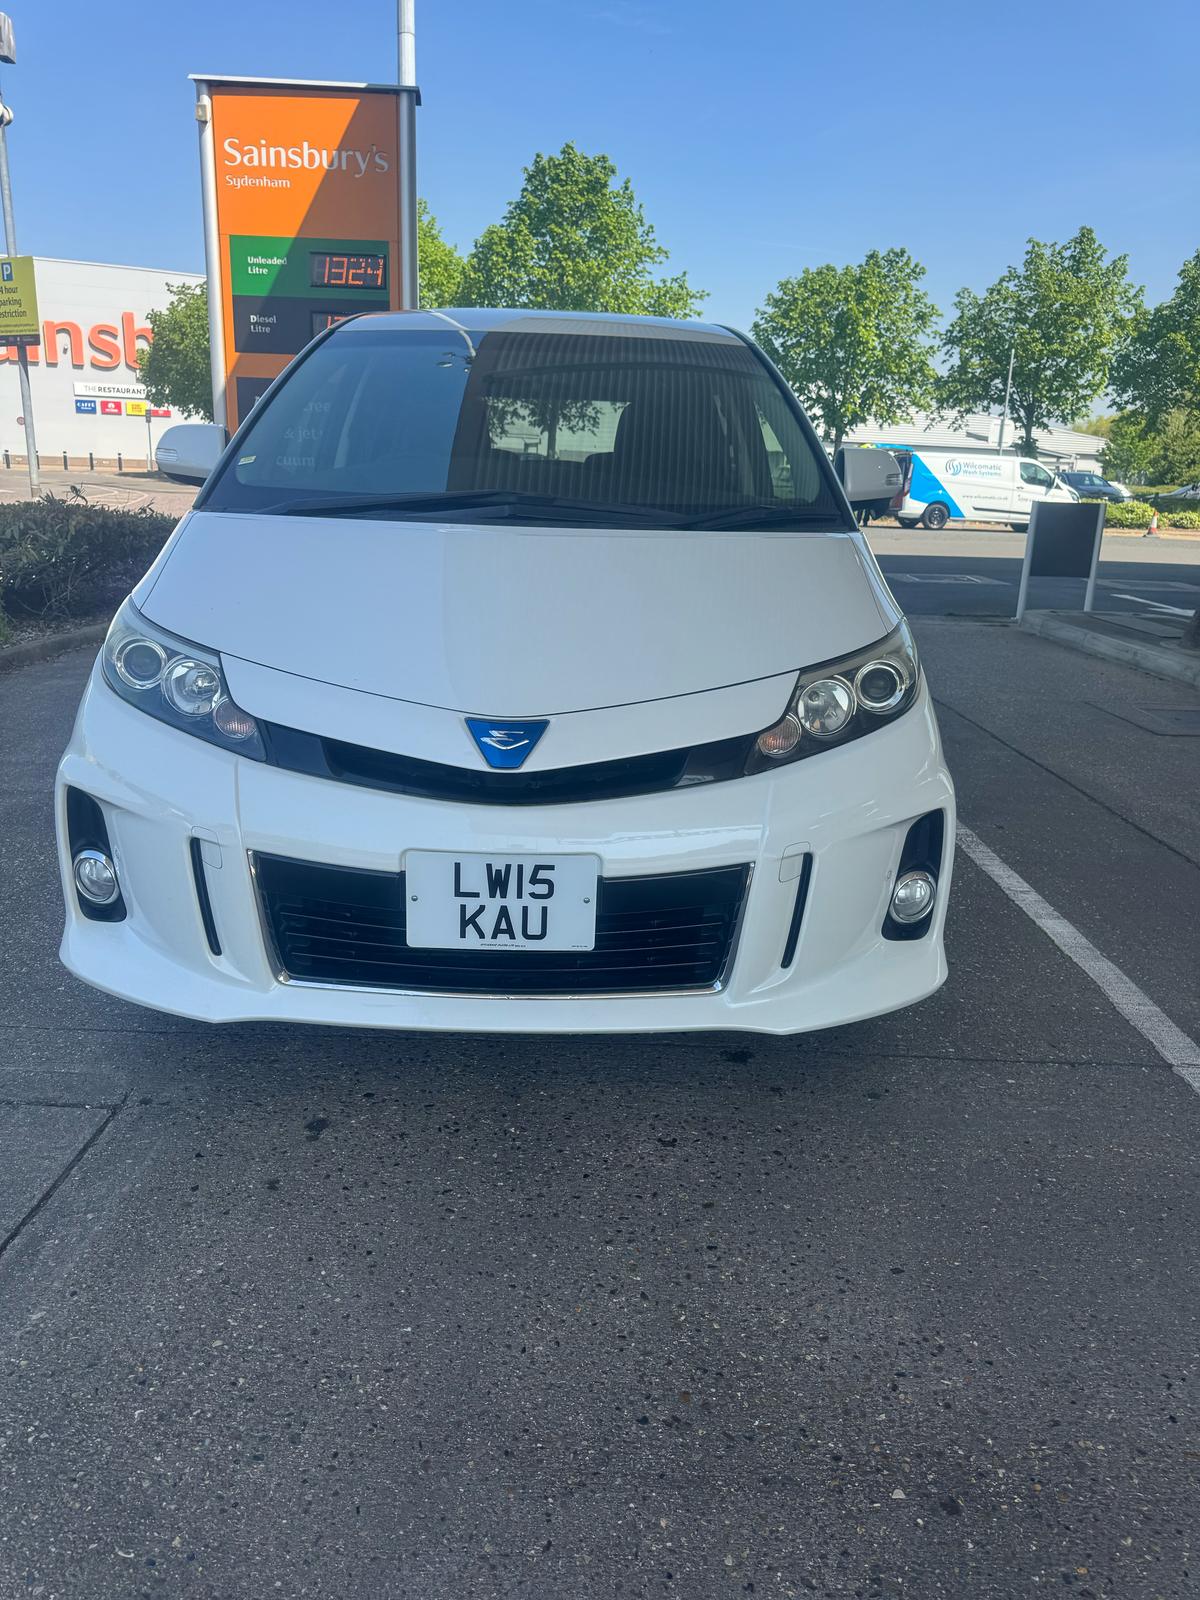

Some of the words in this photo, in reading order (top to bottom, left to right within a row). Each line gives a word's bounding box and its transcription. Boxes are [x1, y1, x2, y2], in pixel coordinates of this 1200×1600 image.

[223, 137, 391, 178] Sainsbury's
[225, 174, 291, 190] Sydenham
[247, 255, 288, 266] Unleaded
[247, 265, 269, 276] Litre
[4, 286, 18, 294] hour
[249, 314, 277, 325] Diesel
[250, 323, 271, 334] Litre
[963, 461, 1002, 471] Wilcomatic
[454, 862, 555, 900] LW15
[459, 904, 548, 940] KAU
